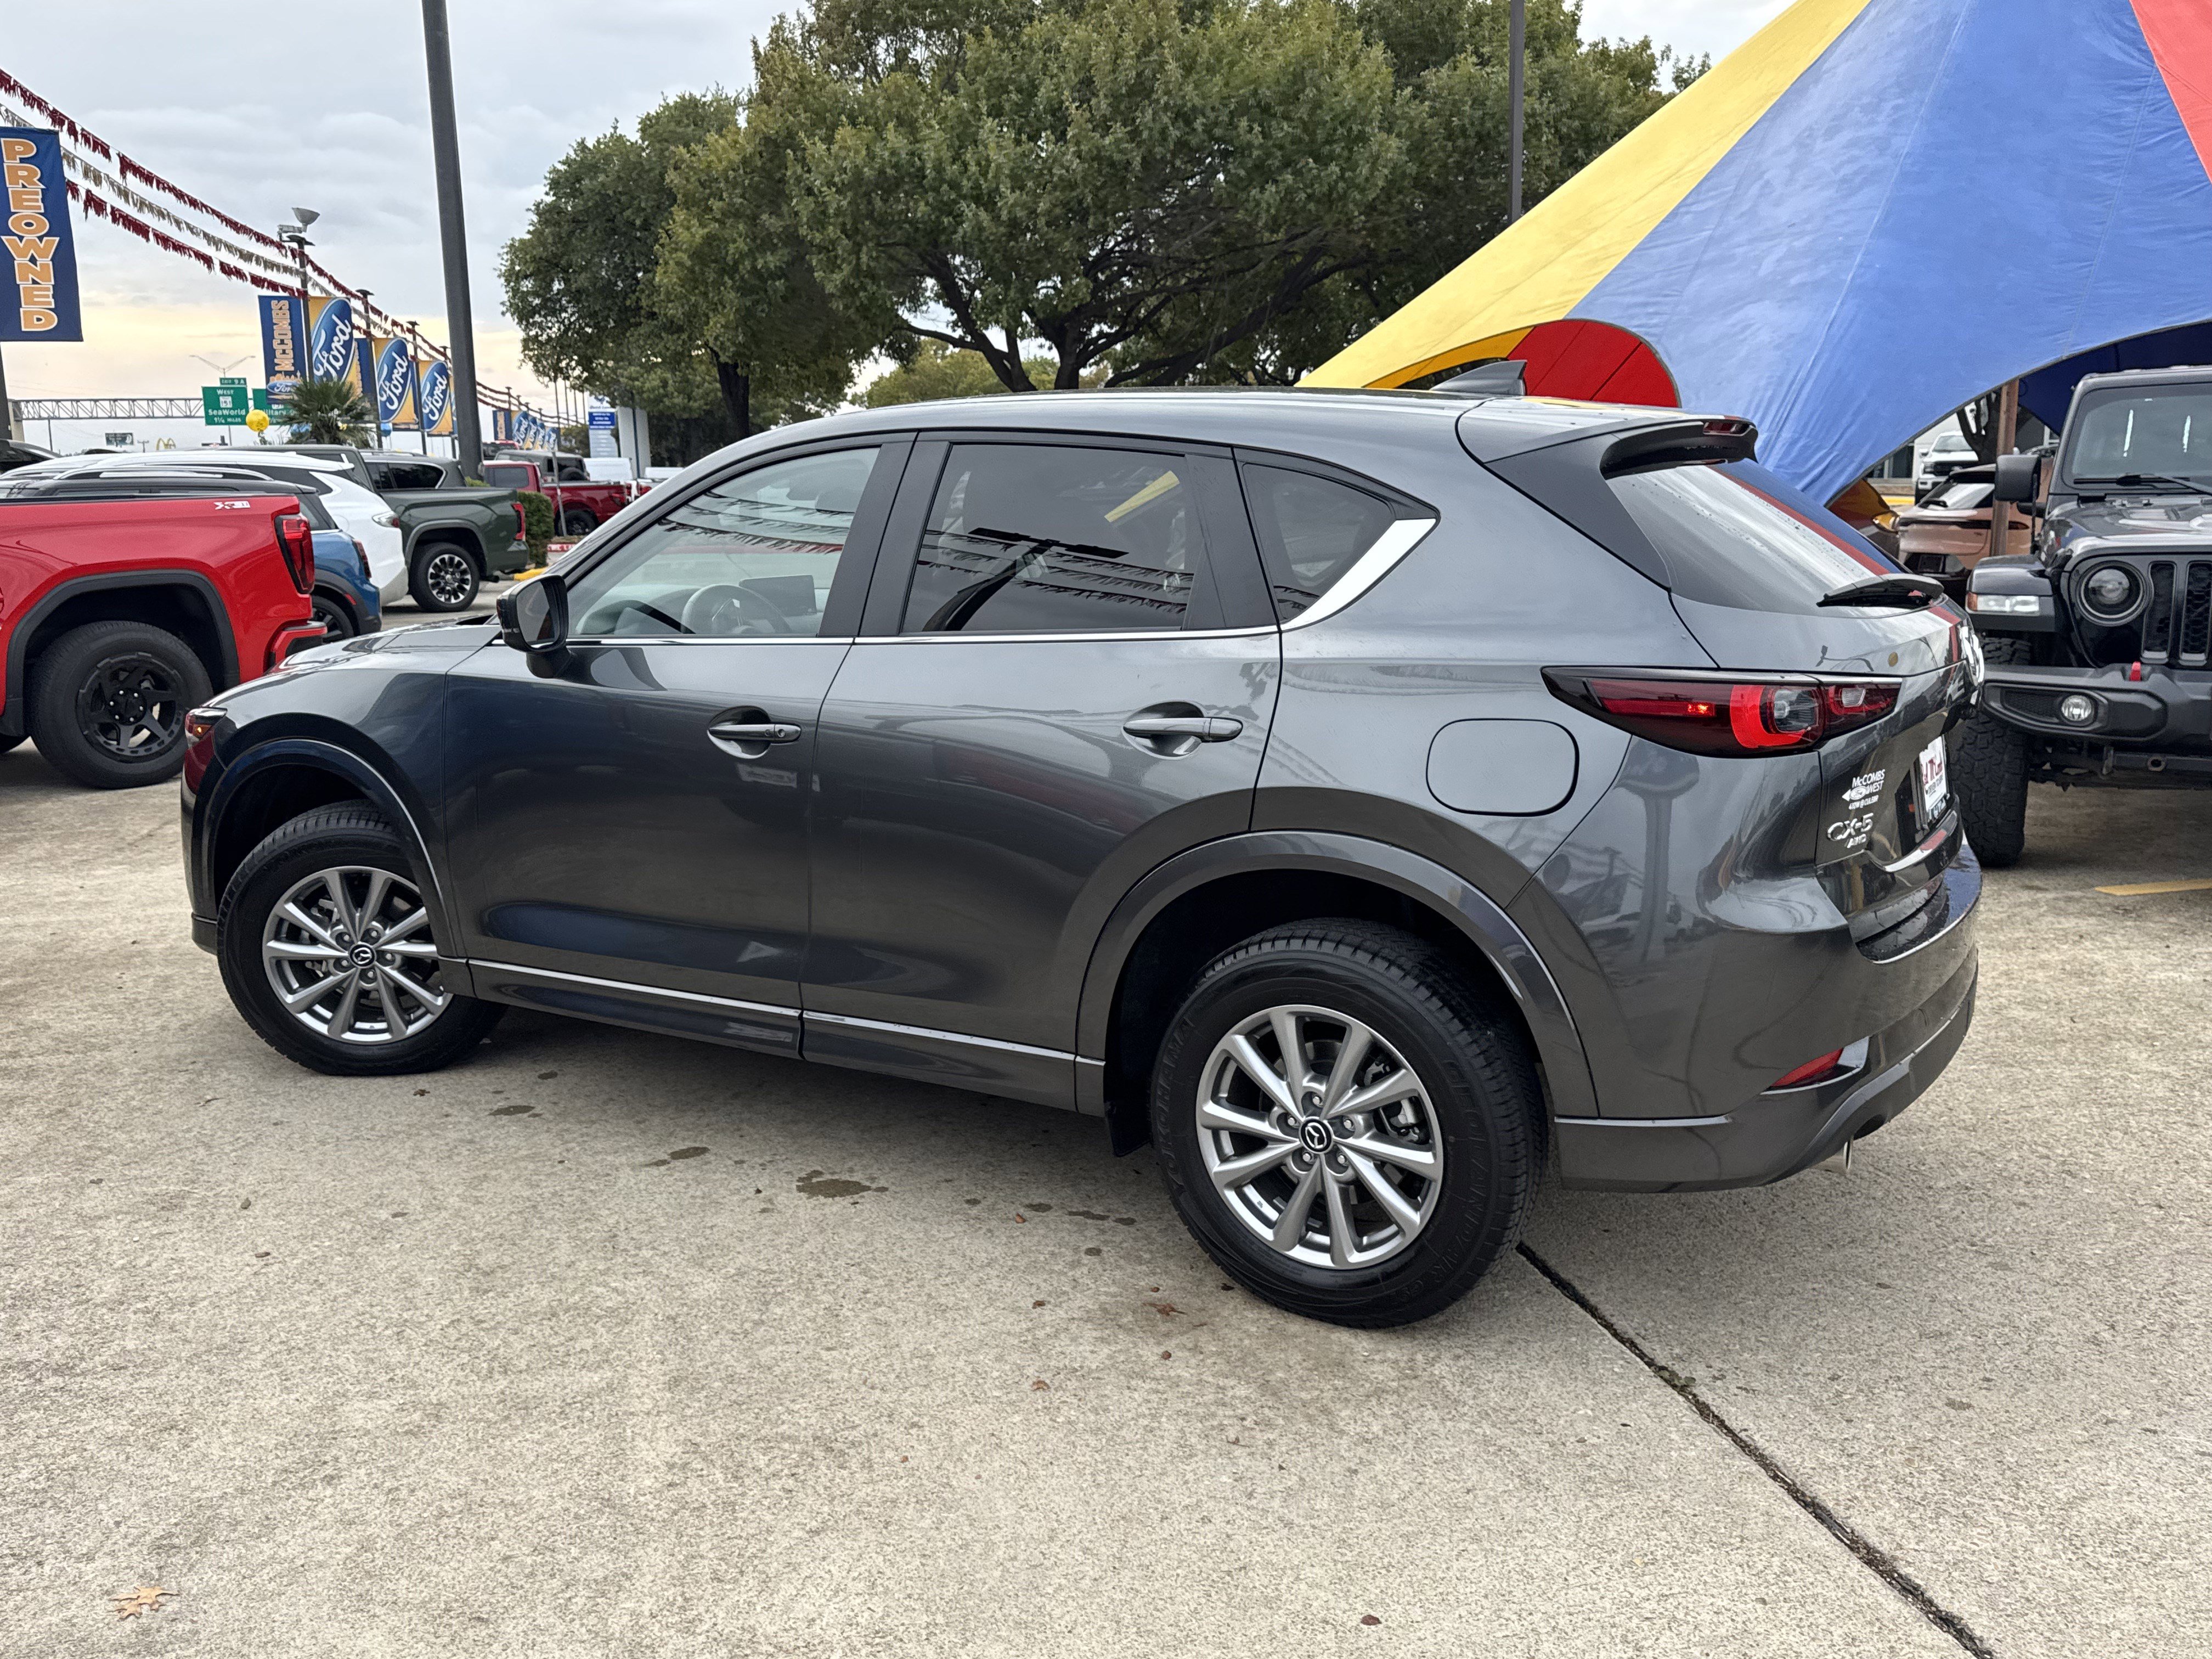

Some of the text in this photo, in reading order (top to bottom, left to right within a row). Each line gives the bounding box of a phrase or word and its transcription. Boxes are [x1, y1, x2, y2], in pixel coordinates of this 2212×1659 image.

[1, 138, 59, 331] PREOWNED
[271, 300, 295, 371] MCCOMBS
[313, 314, 351, 383] Ford
[380, 351, 408, 410] Ford
[422, 371, 448, 421] Ford
[1866, 780, 1884, 795] WEST
[1827, 812, 1874, 842] CX-5
